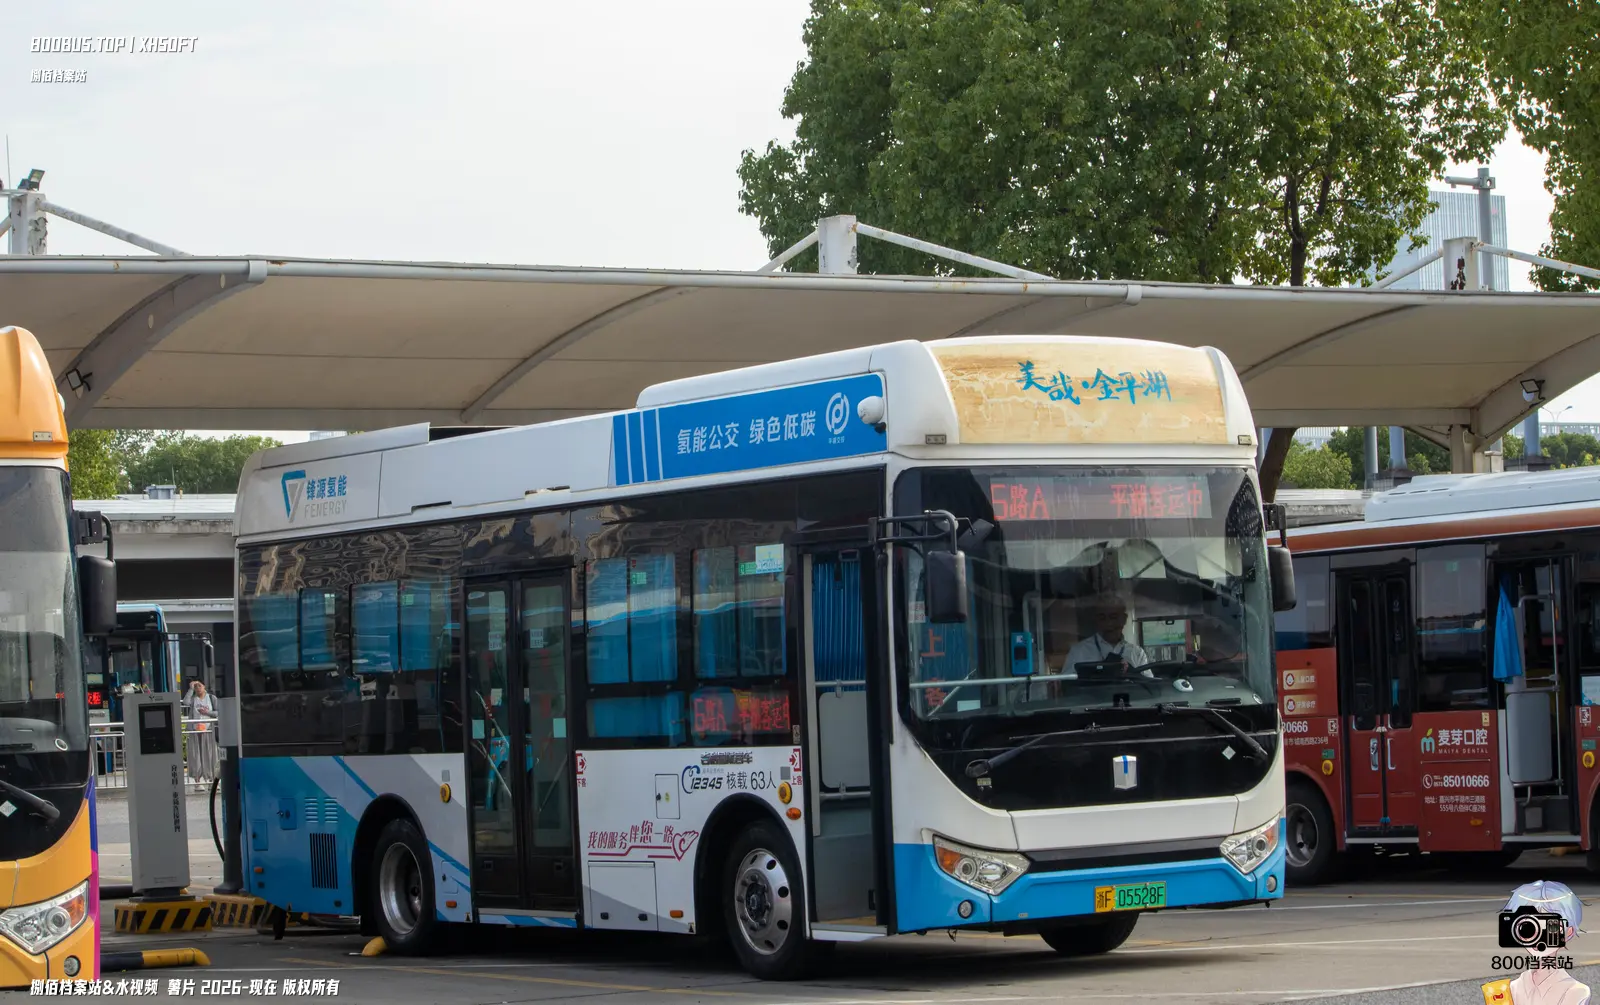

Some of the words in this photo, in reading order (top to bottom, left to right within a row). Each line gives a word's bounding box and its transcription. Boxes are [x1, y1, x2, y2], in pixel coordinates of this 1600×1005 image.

[676, 422, 740, 455] 氢能公交
[749, 410, 817, 444] 绿色低碳
[304, 501, 346, 518] FENERGY
[990, 483, 1050, 521] 5路A
[1438, 729, 1488, 746] 麦芽口腔
[690, 777, 724, 790] 12345
[726, 771, 748, 790] 核载
[750, 771, 777, 790] 63人
[1443, 775, 1490, 787] 85010666
[587, 820, 675, 850] 我的服务伴您一路
[1118, 886, 1164, 907] 05528F
